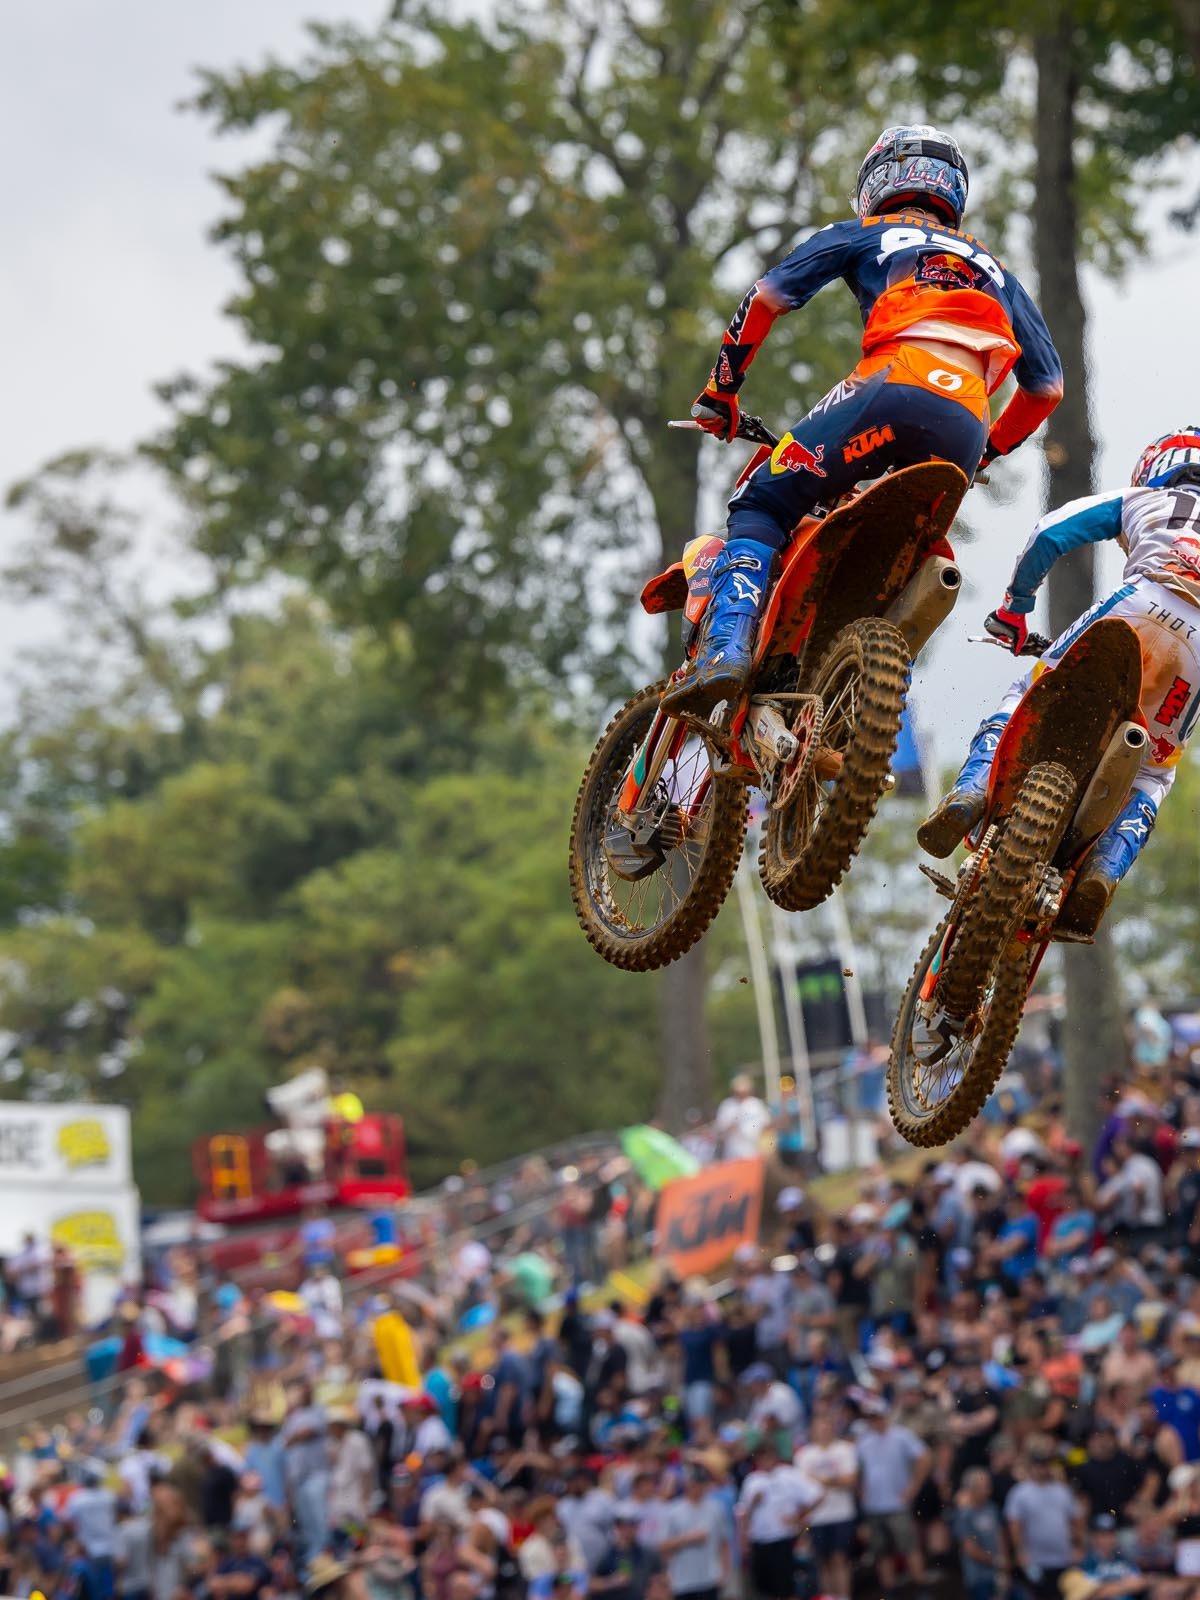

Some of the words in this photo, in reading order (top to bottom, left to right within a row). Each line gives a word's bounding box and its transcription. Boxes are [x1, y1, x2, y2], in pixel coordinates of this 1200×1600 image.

[842, 424, 896, 464] KTM
[1168, 548, 1199, 570] Red
[1154, 675, 1192, 727] KTM
